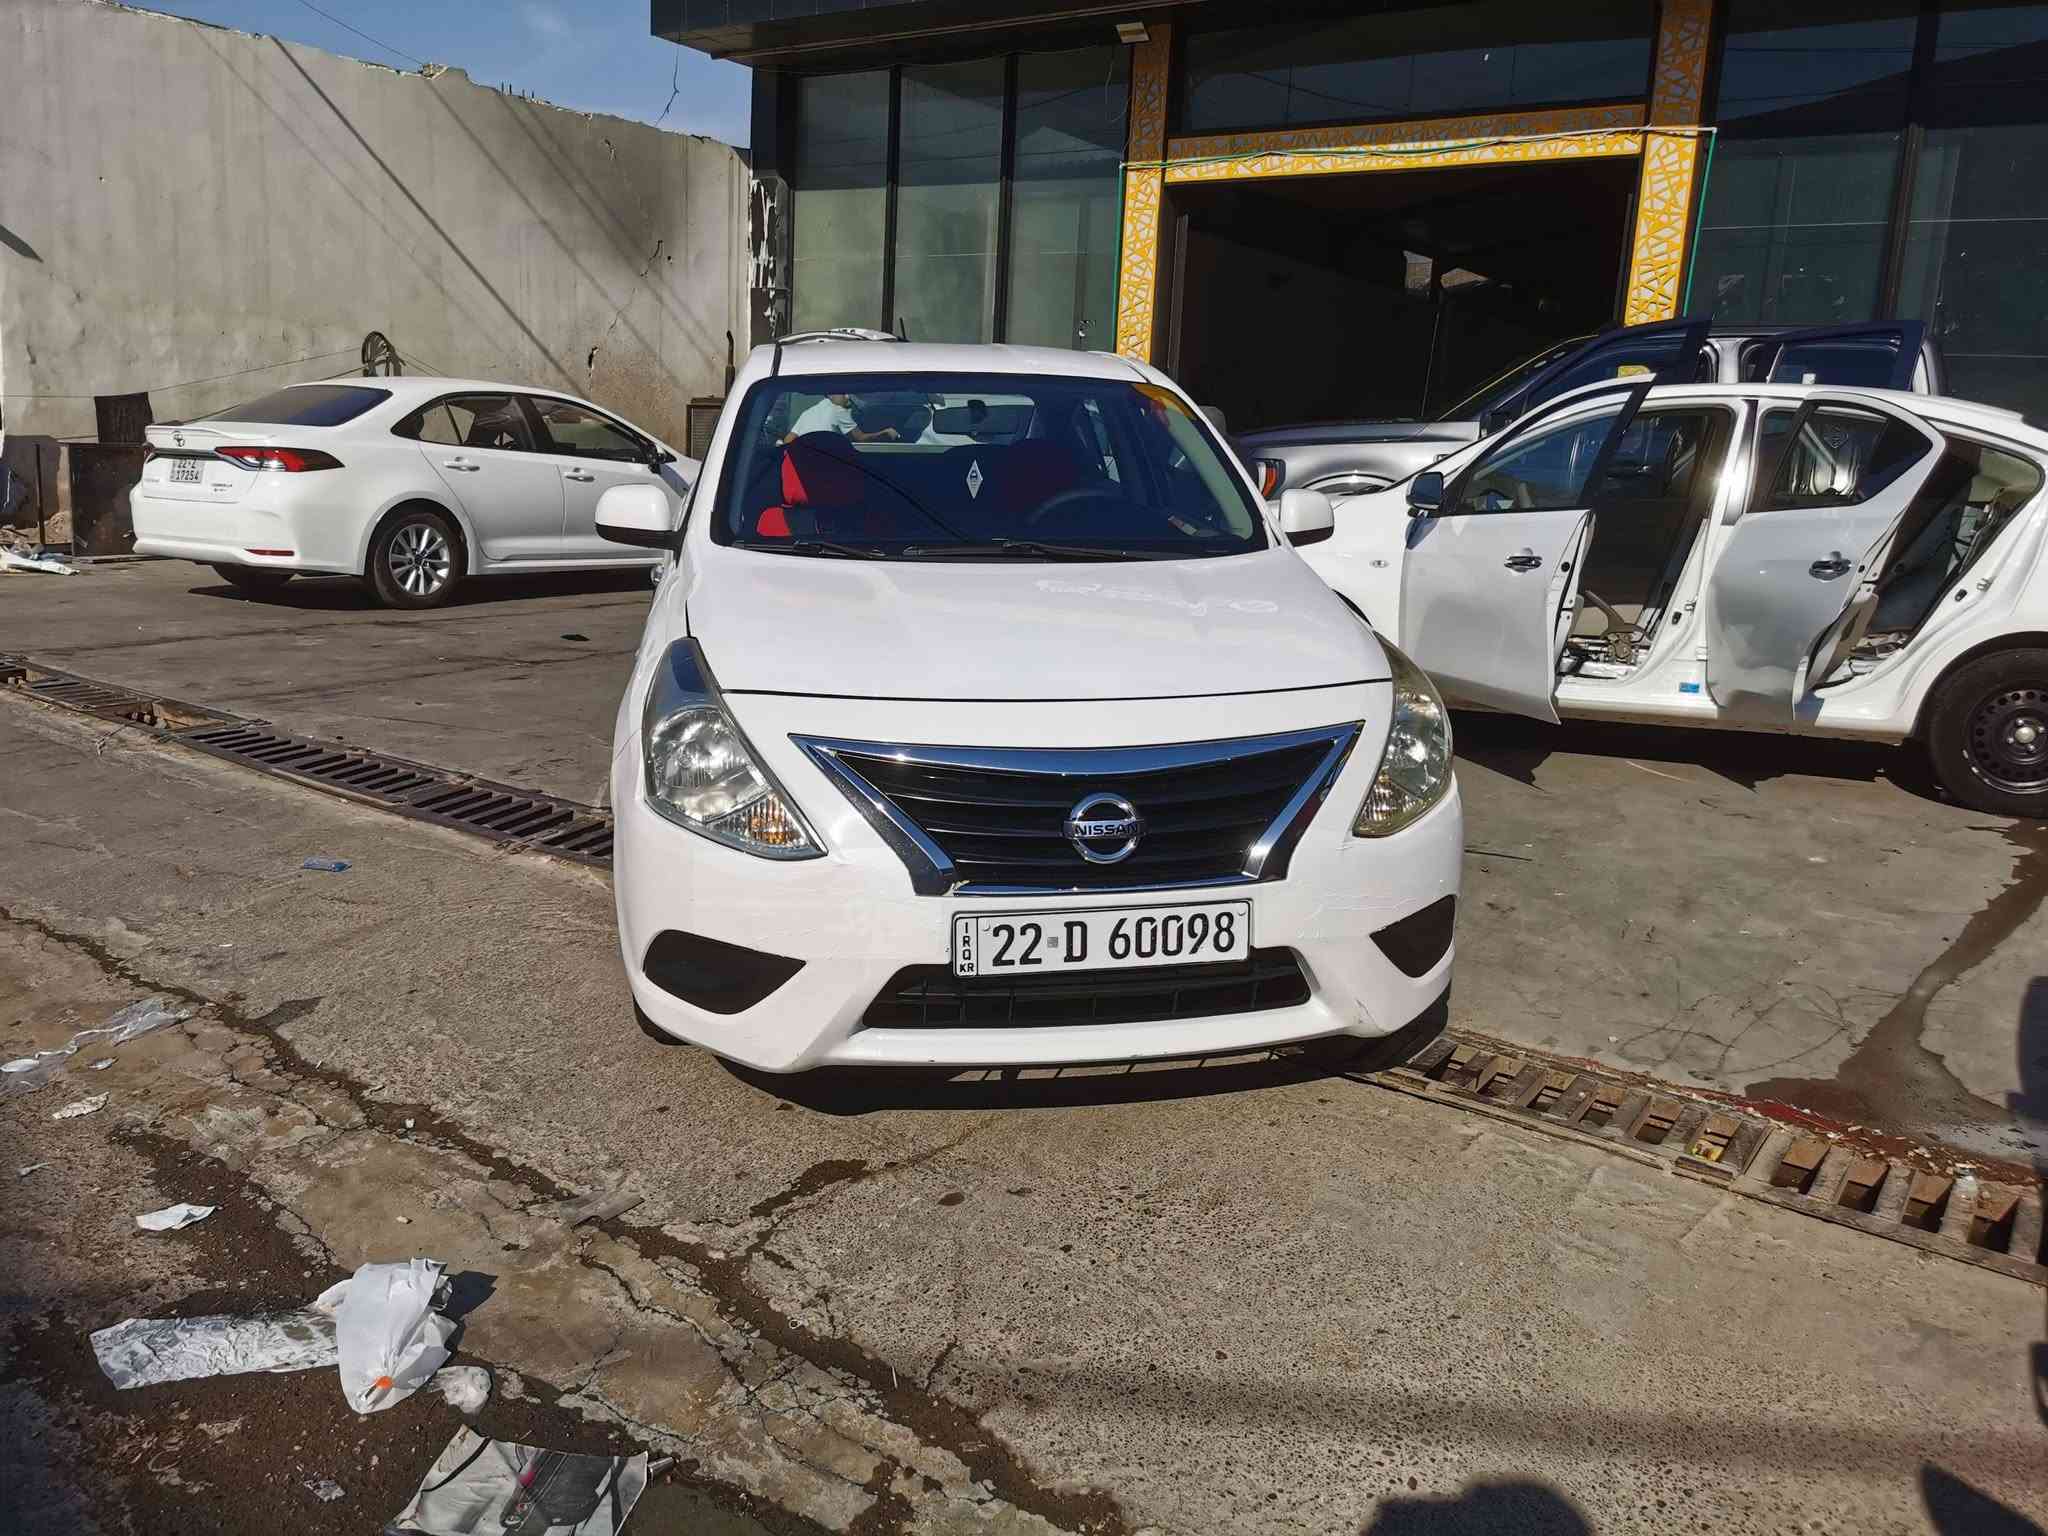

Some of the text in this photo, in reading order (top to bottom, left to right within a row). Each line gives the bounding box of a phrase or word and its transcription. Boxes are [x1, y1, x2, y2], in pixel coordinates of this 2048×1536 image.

[176, 470, 199, 480] 17254
[1075, 824, 1137, 836] NISSAN
[962, 922, 972, 961] IRQ
[992, 911, 1236, 967] 22 D 60098
[959, 963, 975, 973] KR
